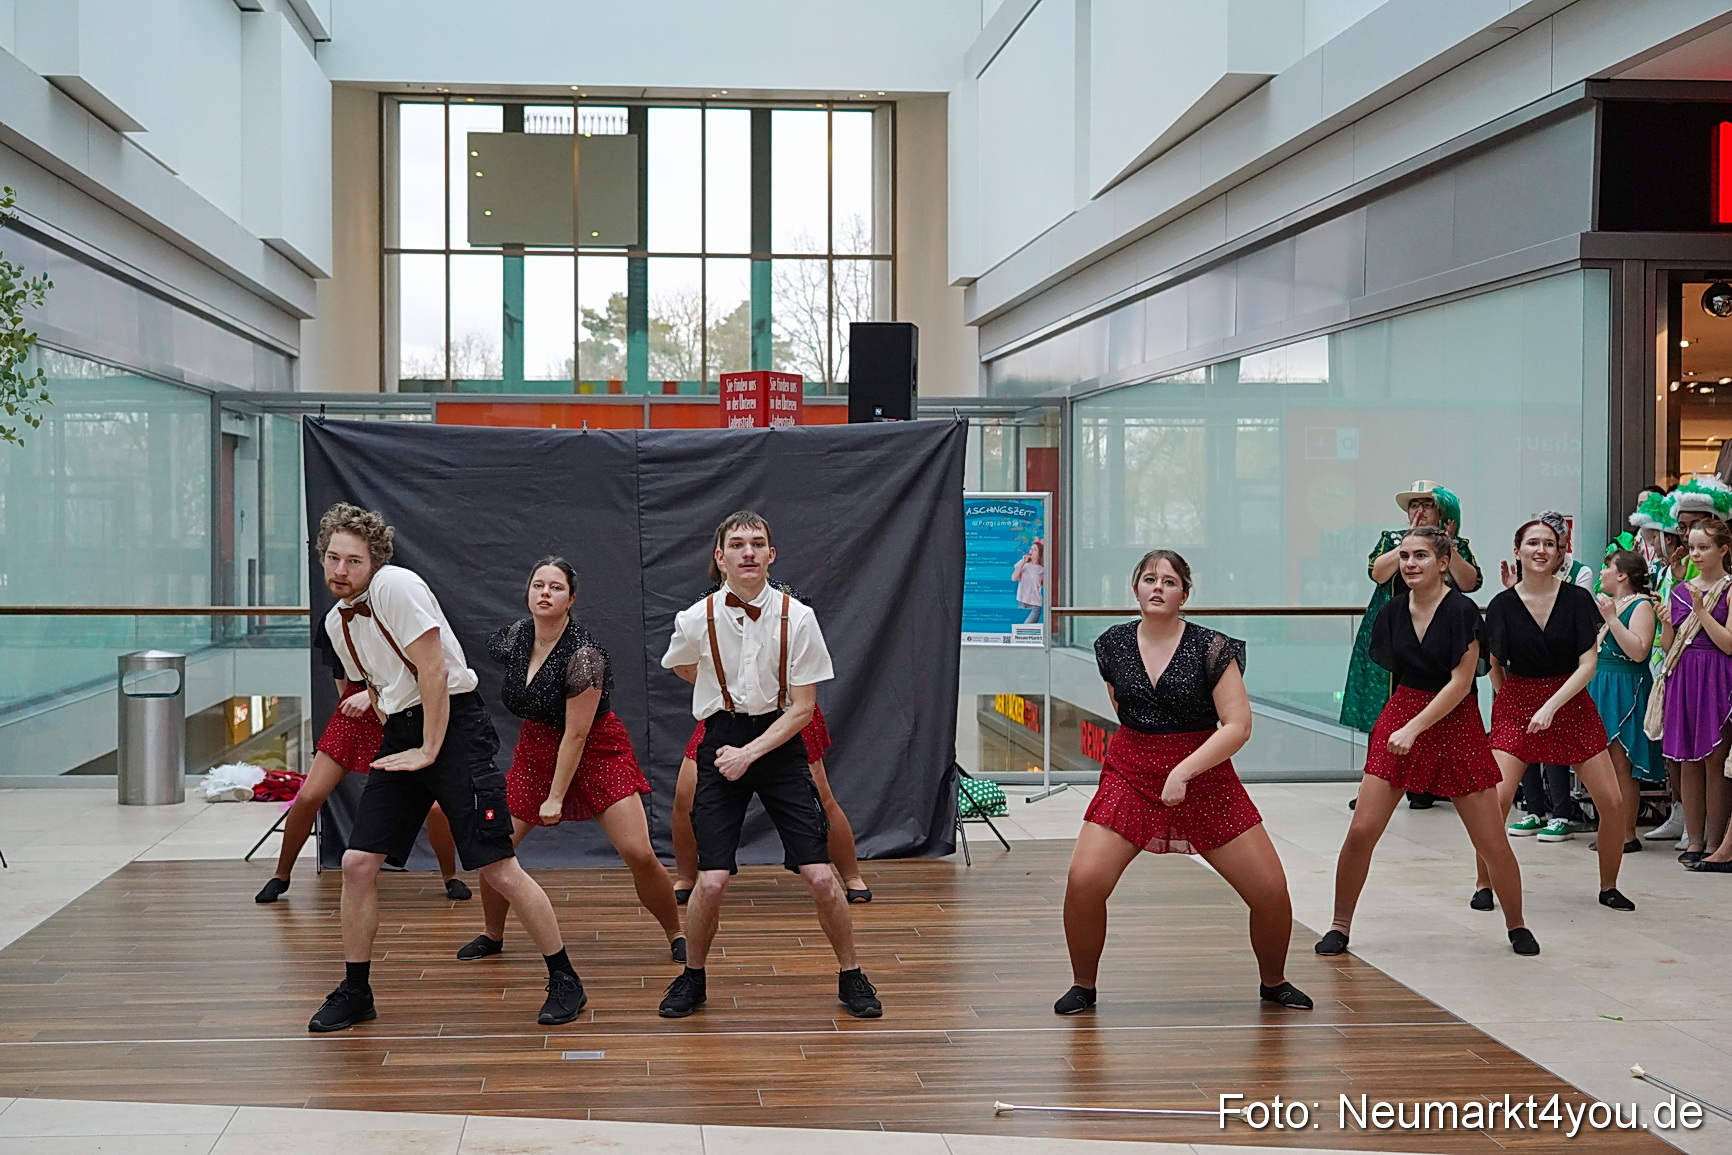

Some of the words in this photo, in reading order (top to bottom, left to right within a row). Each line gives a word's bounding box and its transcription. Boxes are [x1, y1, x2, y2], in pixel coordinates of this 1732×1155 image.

[734, 378, 748, 392] finden
[749, 380, 757, 391] uns
[769, 377, 777, 391] Sie
[777, 377, 789, 392] finden
[726, 397, 731, 410] in
[770, 396, 774, 409] in
[965, 506, 1036, 517] ASCHINGSZEIT
[1081, 720, 1107, 764] REWE
